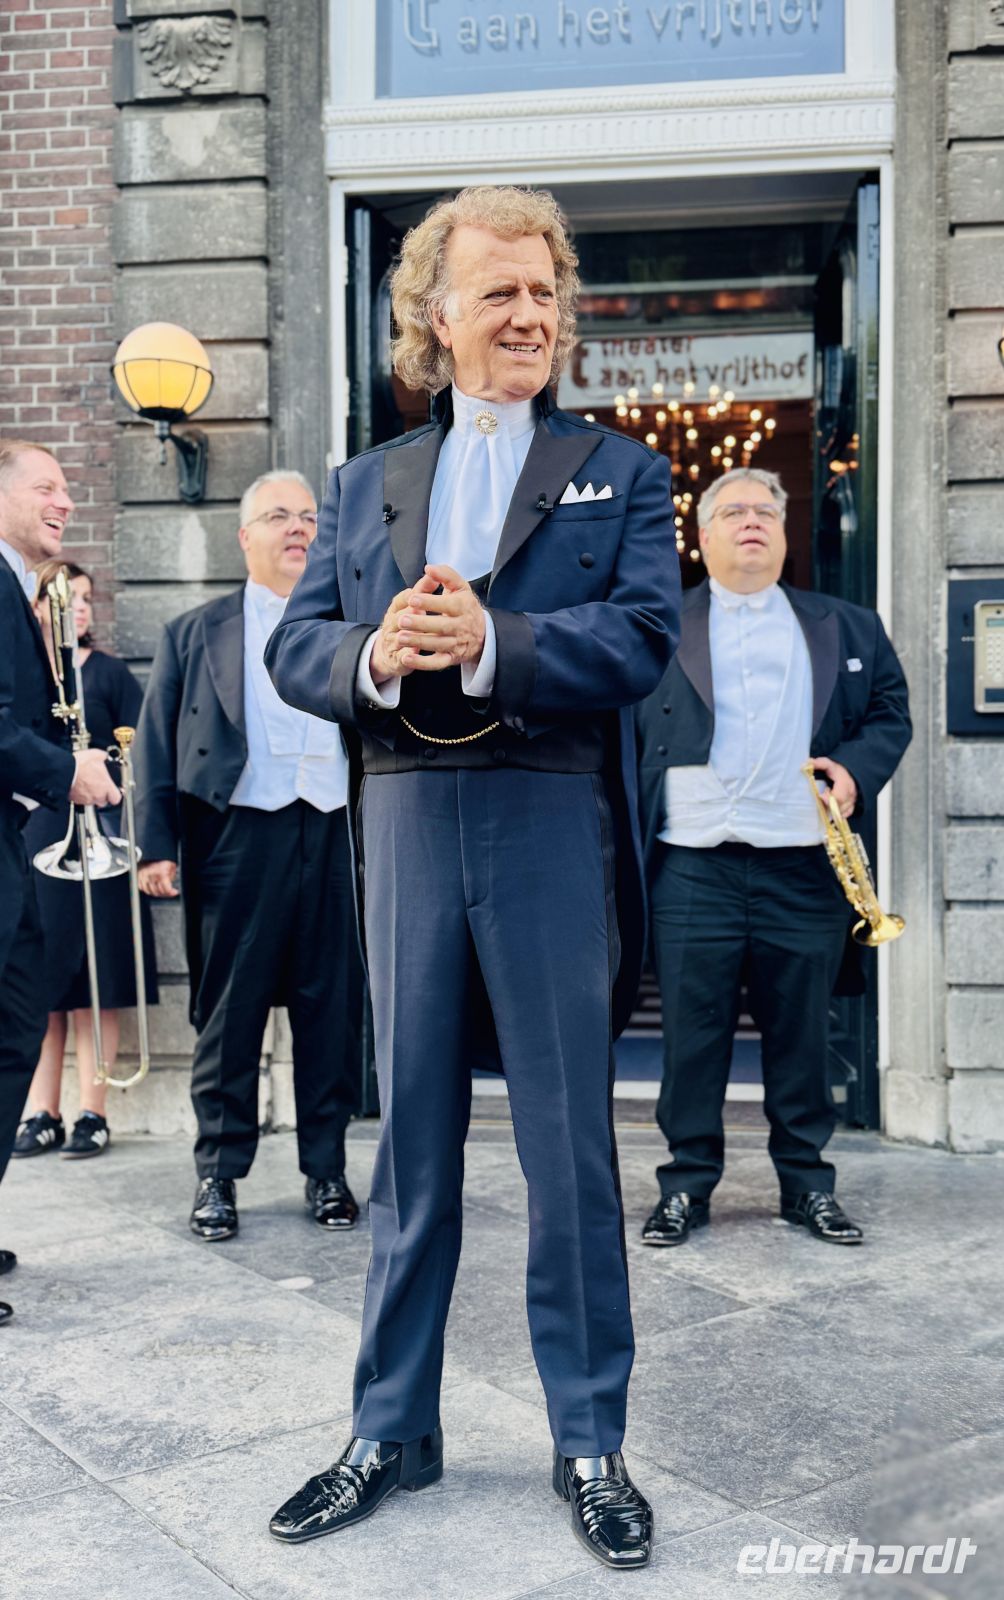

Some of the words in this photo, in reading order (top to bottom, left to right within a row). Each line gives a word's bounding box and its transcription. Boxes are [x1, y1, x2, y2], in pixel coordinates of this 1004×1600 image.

[456, 12, 537, 46] aan
[557, 0, 631, 38] het
[601, 366, 646, 387] aan
[655, 359, 697, 386] het
[706, 353, 808, 385] vrijthof
